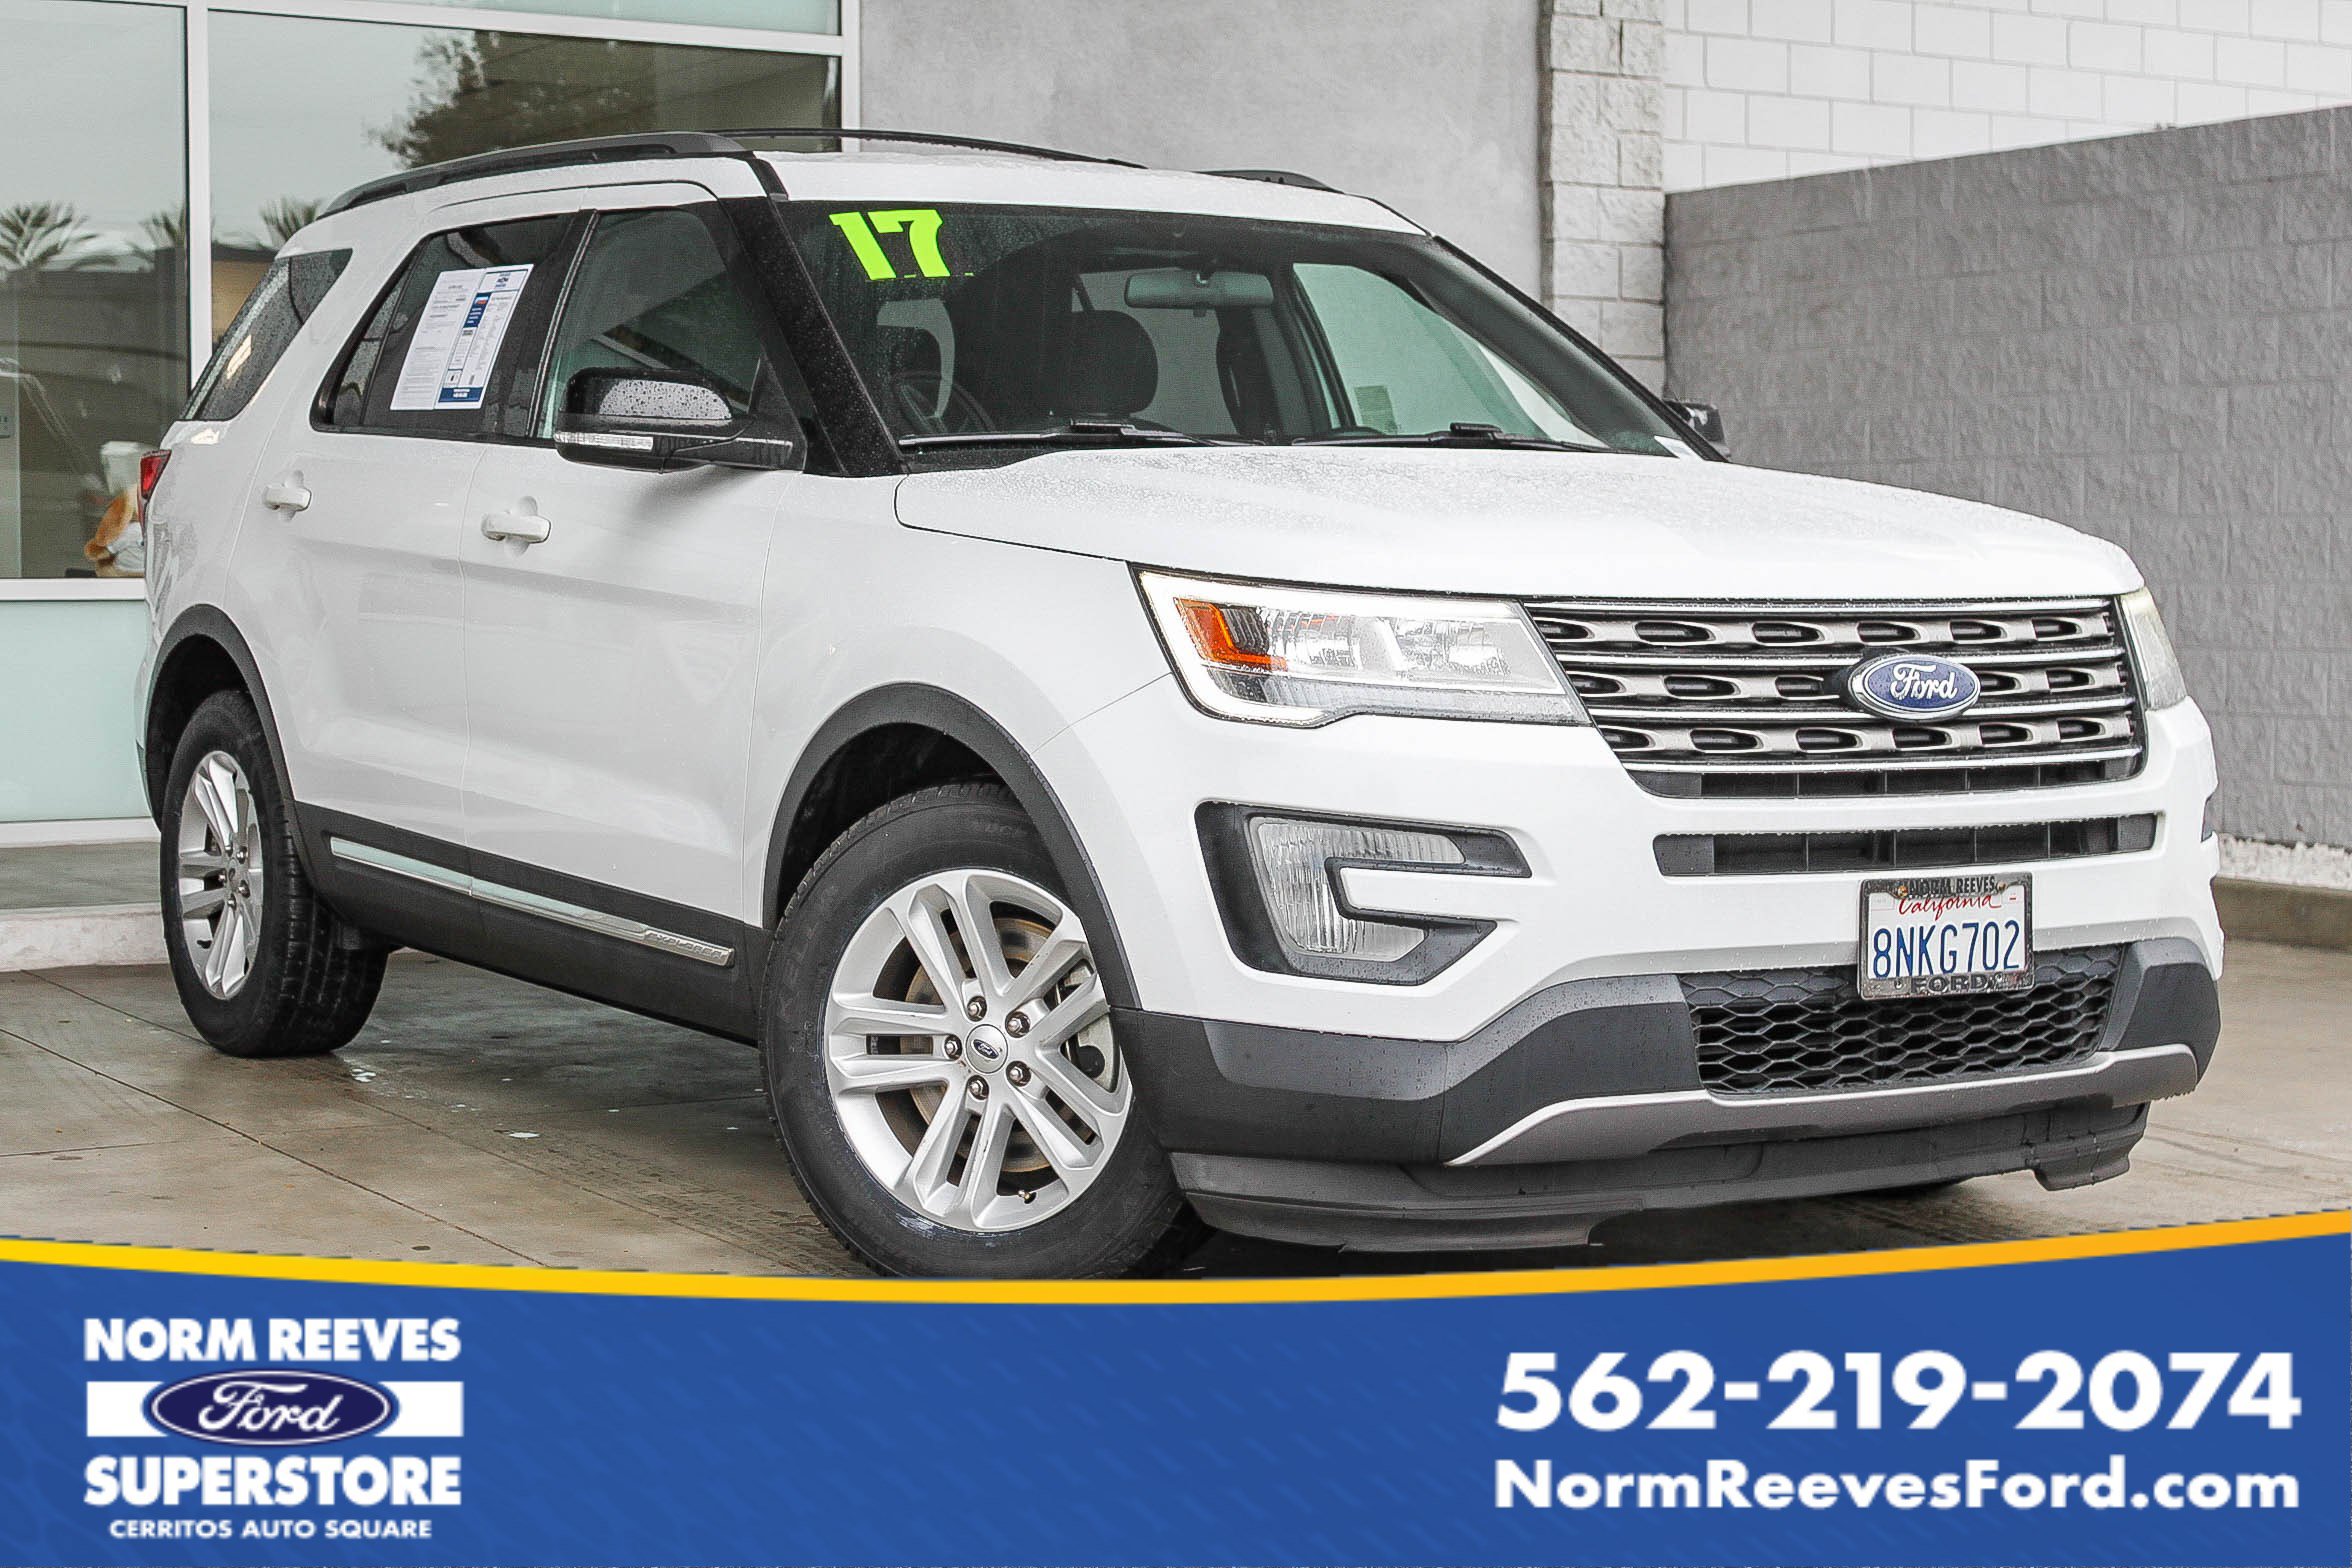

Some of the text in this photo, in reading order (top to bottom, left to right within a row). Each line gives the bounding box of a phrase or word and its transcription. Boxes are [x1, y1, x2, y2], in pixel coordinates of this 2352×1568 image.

[829, 209, 951, 281] 17
[1889, 663, 1958, 700] Ford
[1956, 875, 1996, 894] REEVES
[1898, 894, 2002, 922] California
[646, 931, 723, 960] EXPLORER
[1873, 919, 2020, 979] 8NKG702
[1910, 973, 1989, 994] FORD
